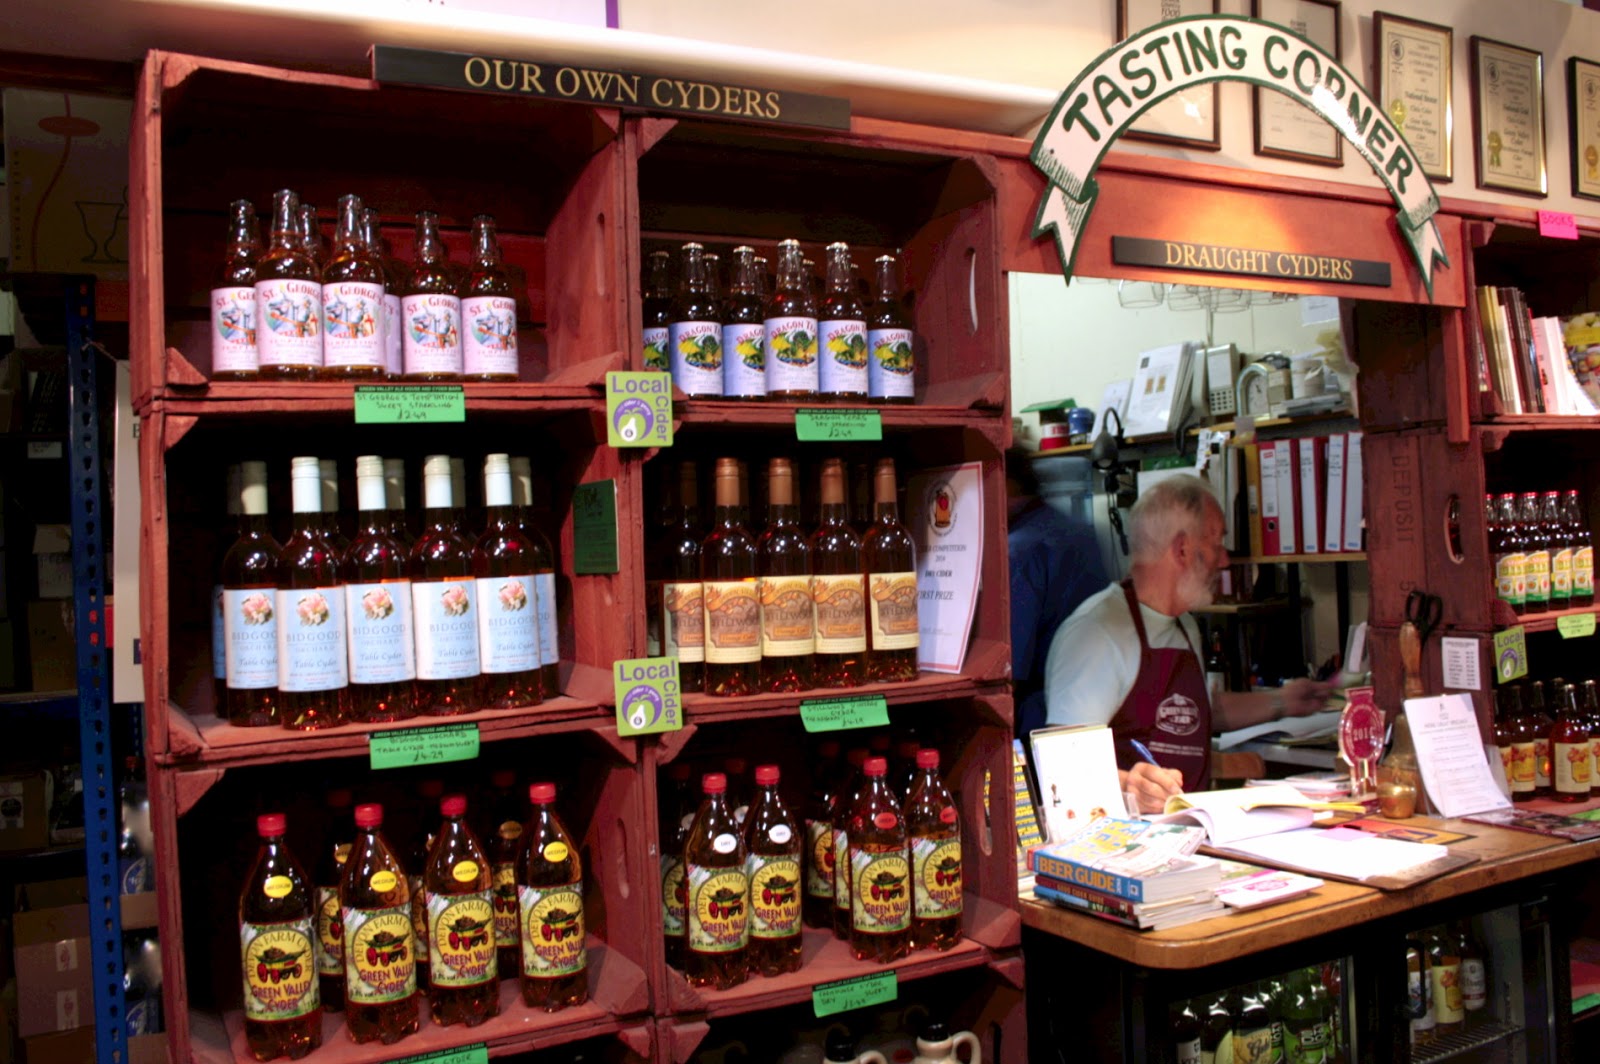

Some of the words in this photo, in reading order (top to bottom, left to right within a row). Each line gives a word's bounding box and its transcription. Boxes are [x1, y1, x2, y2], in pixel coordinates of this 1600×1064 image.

[464, 57, 545, 93] OUR
[555, 67, 640, 103] OWN
[651, 78, 780, 119] CYDERS
[1063, 25, 1247, 142] TASTING
[1263, 36, 1414, 194] CORNER
[1165, 242, 1271, 273] DRAUGHT
[1276, 253, 1353, 281] CYDERS
[612, 375, 668, 393] Local
[655, 396, 669, 441] Cider
[1392, 456, 1414, 542] DEPOSIT
[1497, 628, 1523, 648] Local
[619, 660, 676, 682] Local
[664, 680, 678, 726] Cider
[770, 861, 796, 873] FARM
[878, 857, 904, 869] FARM
[717, 873, 741, 886] FARM
[1039, 856, 1074, 881] BEER
[1075, 867, 1116, 892] GUIDE
[548, 892, 576, 905] FARM
[929, 888, 952, 900] GREEN
[1072, 888, 1088, 899] CIDER
[1088, 893, 1104, 903] GUIDE
[455, 901, 484, 914] FARM
[755, 907, 782, 918] GREEN
[865, 902, 890, 915] GREEN
[373, 915, 402, 929] FARM
[702, 920, 729, 932] GREEN
[263, 931, 296, 945] FARM
[535, 944, 565, 957] GREEN
[442, 953, 472, 966] GREEN
[359, 968, 391, 981] GREEN
[251, 984, 281, 999] GREEN
